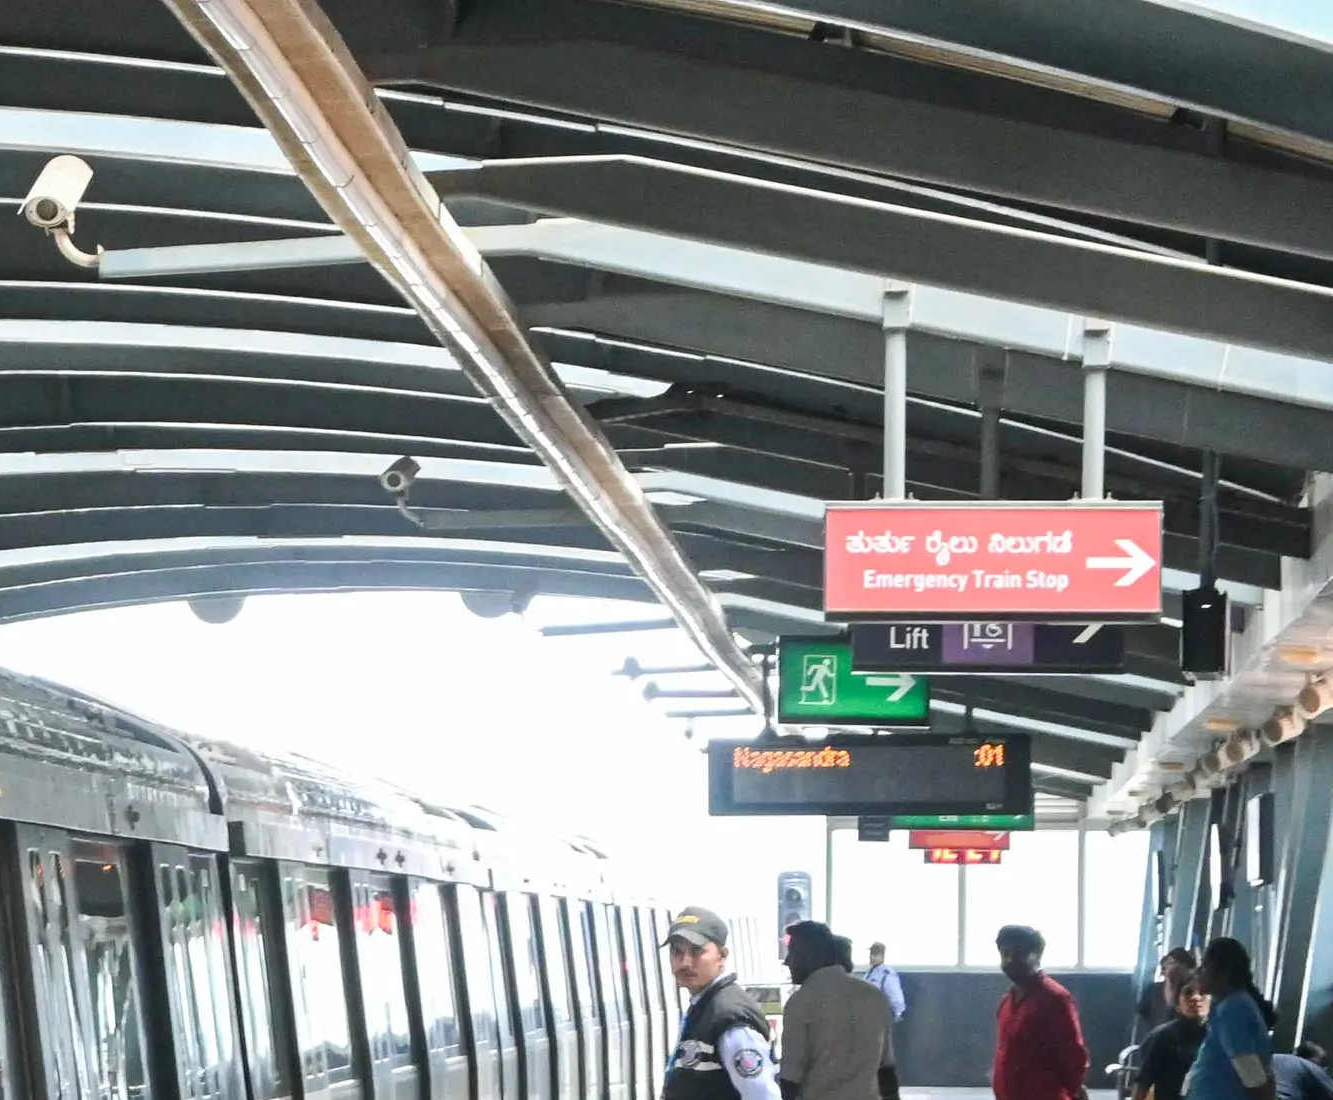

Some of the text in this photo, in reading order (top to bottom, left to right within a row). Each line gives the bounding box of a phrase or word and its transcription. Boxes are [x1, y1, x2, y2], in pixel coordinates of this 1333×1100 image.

[845, 530, 916, 553] ತುರ್ತು
[925, 529, 978, 566] ರೈಲು
[863, 569, 1069, 592] Emergency Train Stop
[889, 626, 930, 649] Lift
[733, 745, 851, 774] Nagasandra
